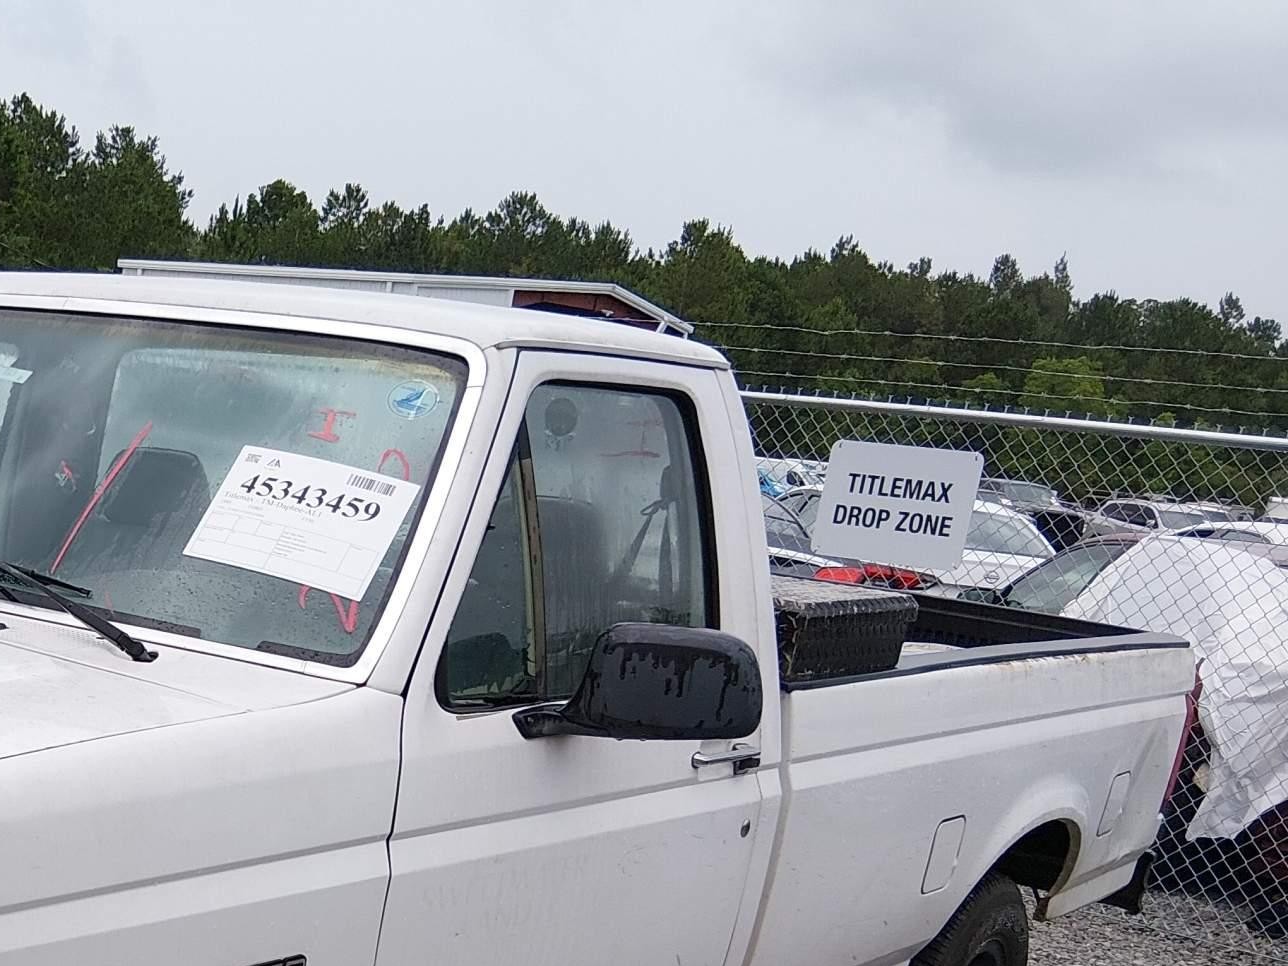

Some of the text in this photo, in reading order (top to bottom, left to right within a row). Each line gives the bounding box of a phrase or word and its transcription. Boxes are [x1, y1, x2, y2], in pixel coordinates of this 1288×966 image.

[239, 473, 381, 522] 45343459
[848, 472, 954, 504] TITLEMAX
[832, 503, 954, 538] DROP ZONE
